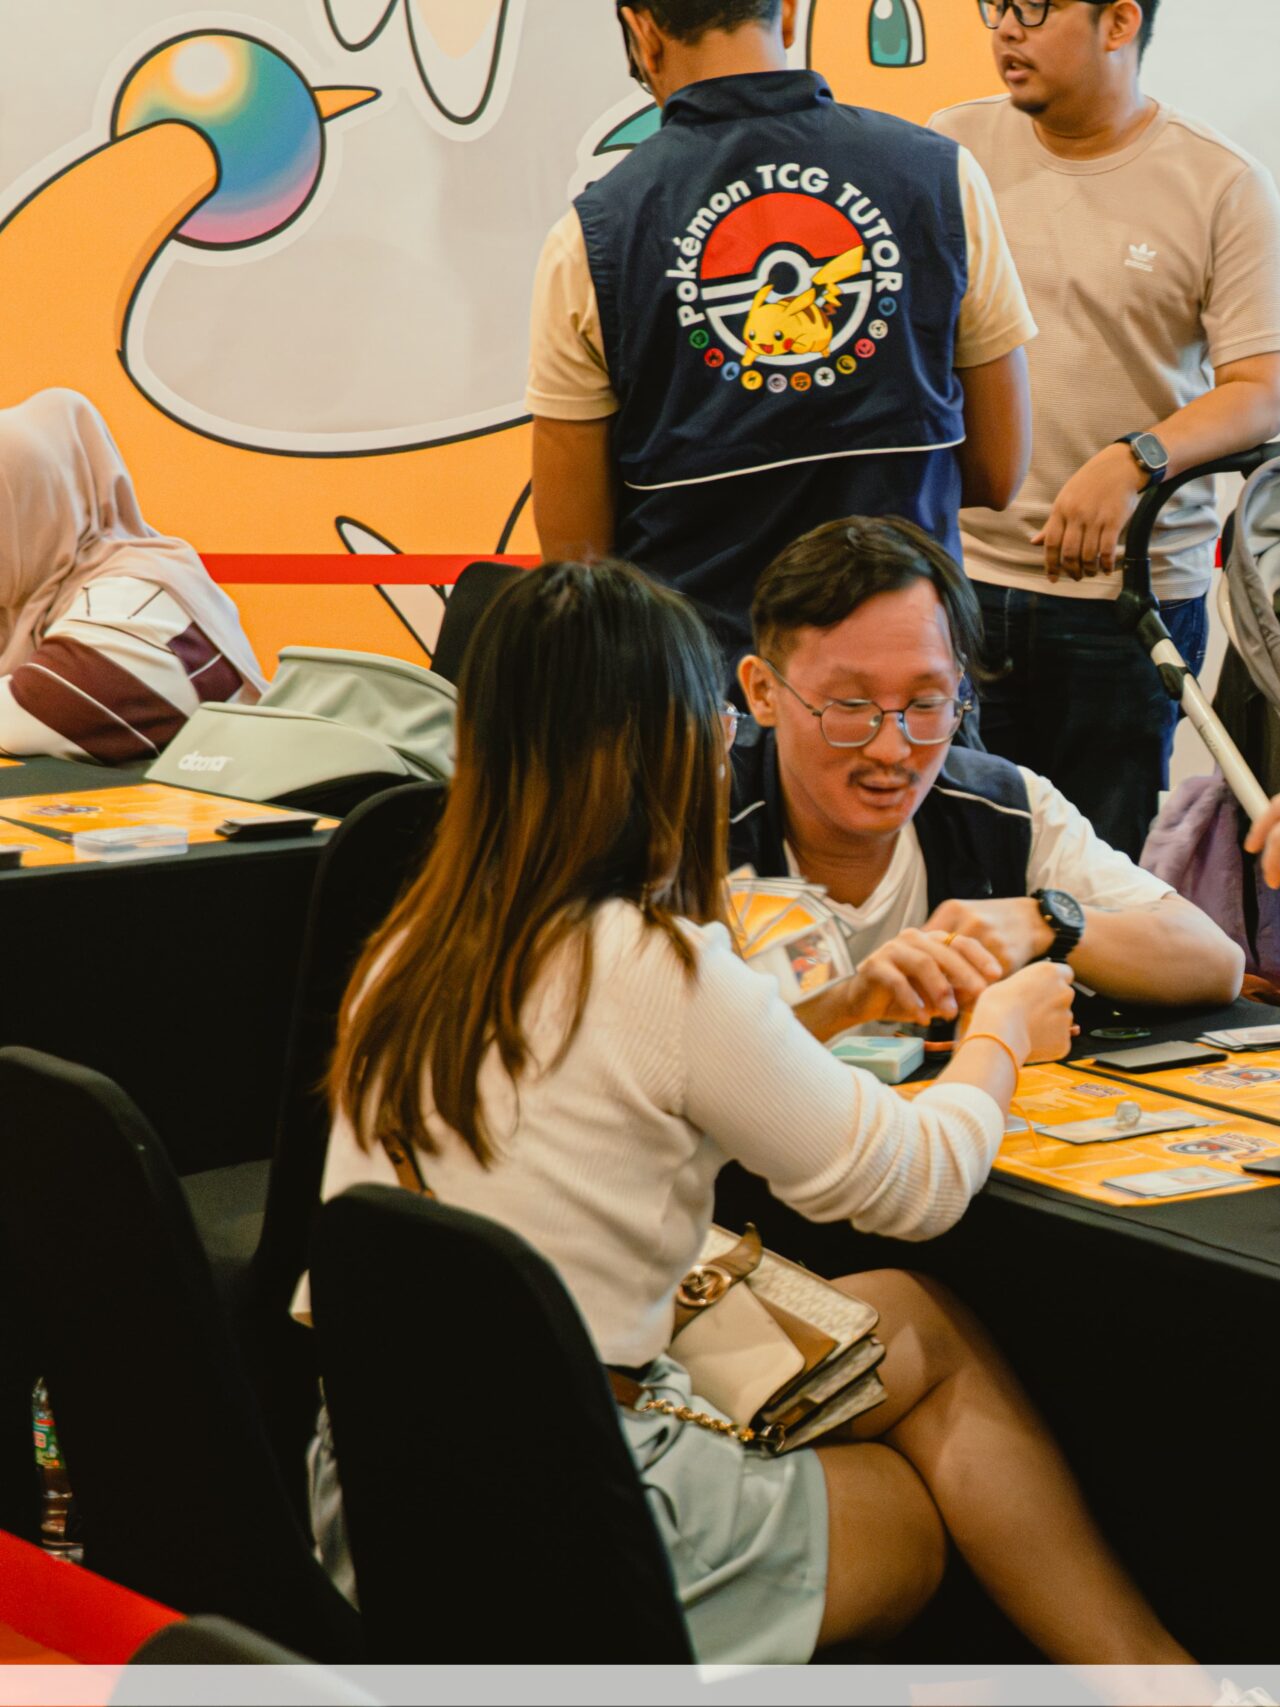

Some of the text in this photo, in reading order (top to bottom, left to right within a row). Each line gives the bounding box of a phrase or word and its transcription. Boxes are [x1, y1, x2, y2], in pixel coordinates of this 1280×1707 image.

[665, 163, 903, 328] Pokémon TCG TUTOR
